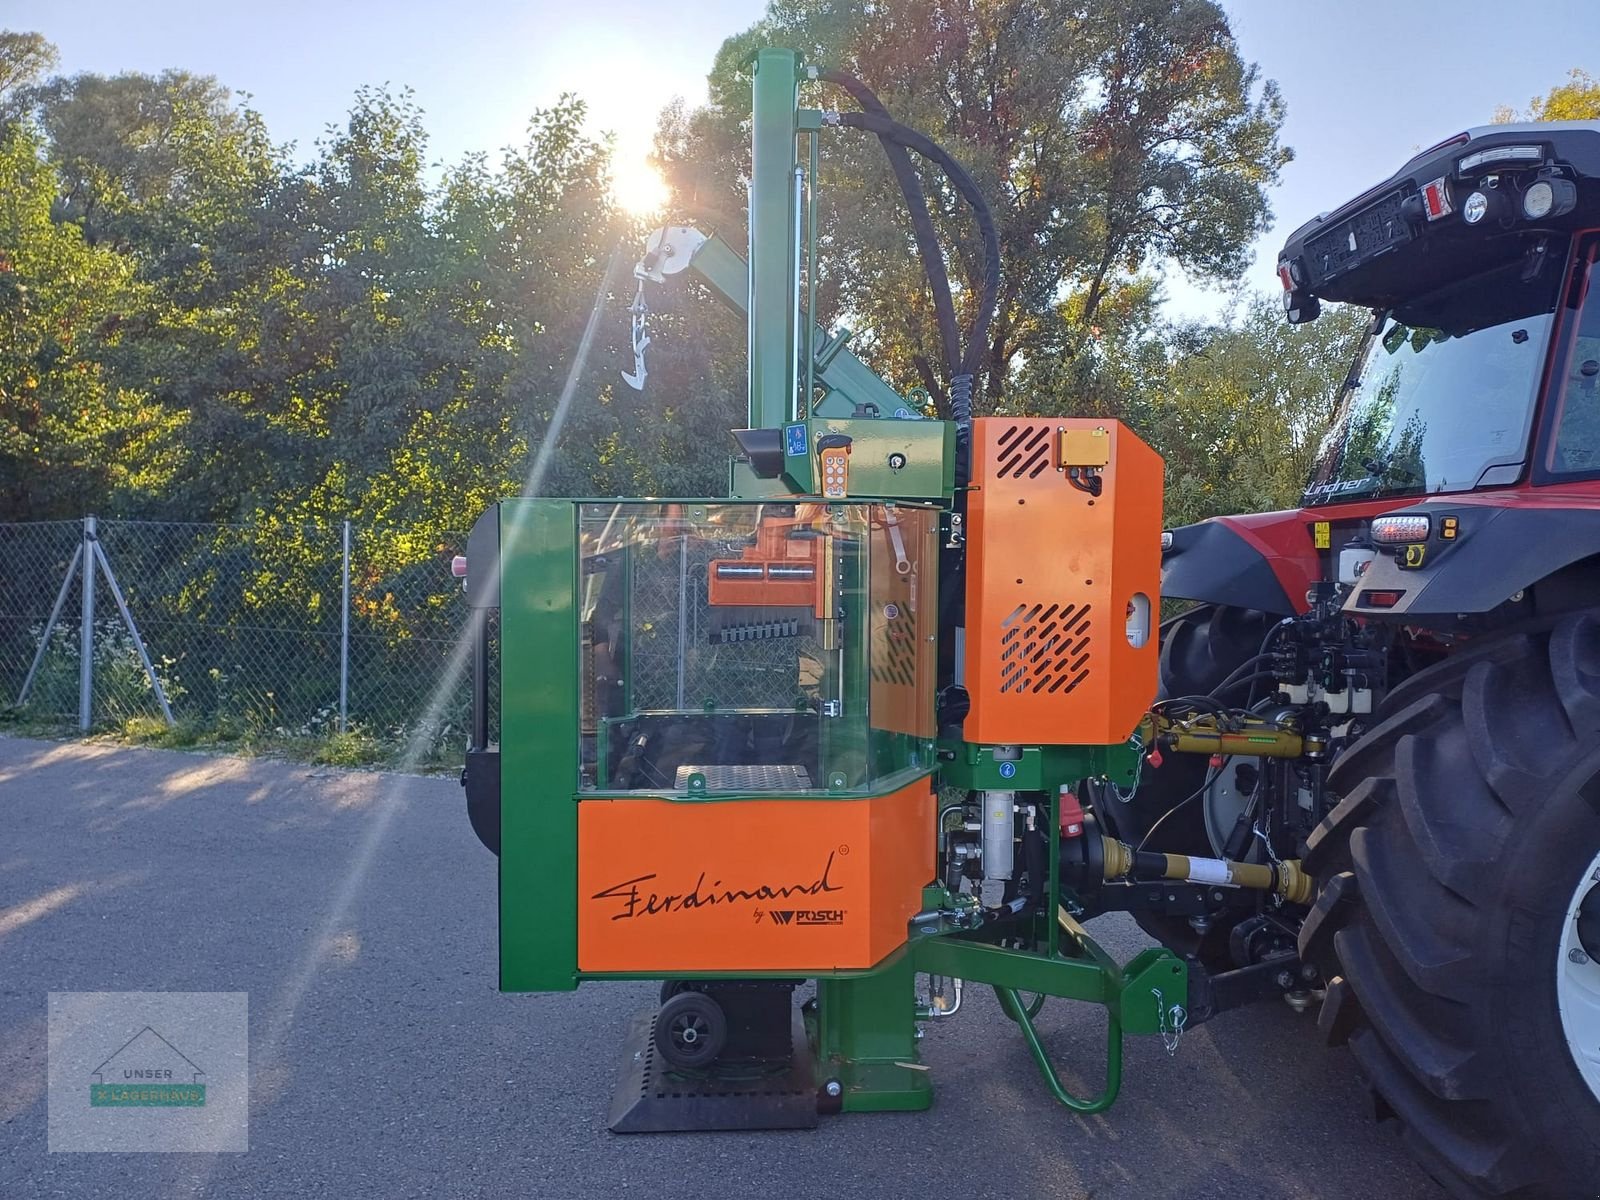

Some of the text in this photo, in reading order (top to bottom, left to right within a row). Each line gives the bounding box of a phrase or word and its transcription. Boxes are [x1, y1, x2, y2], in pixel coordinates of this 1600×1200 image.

[1304, 478, 1371, 496] Lindner
[592, 851, 844, 921] Ferdinand
[753, 908, 764, 924] by
